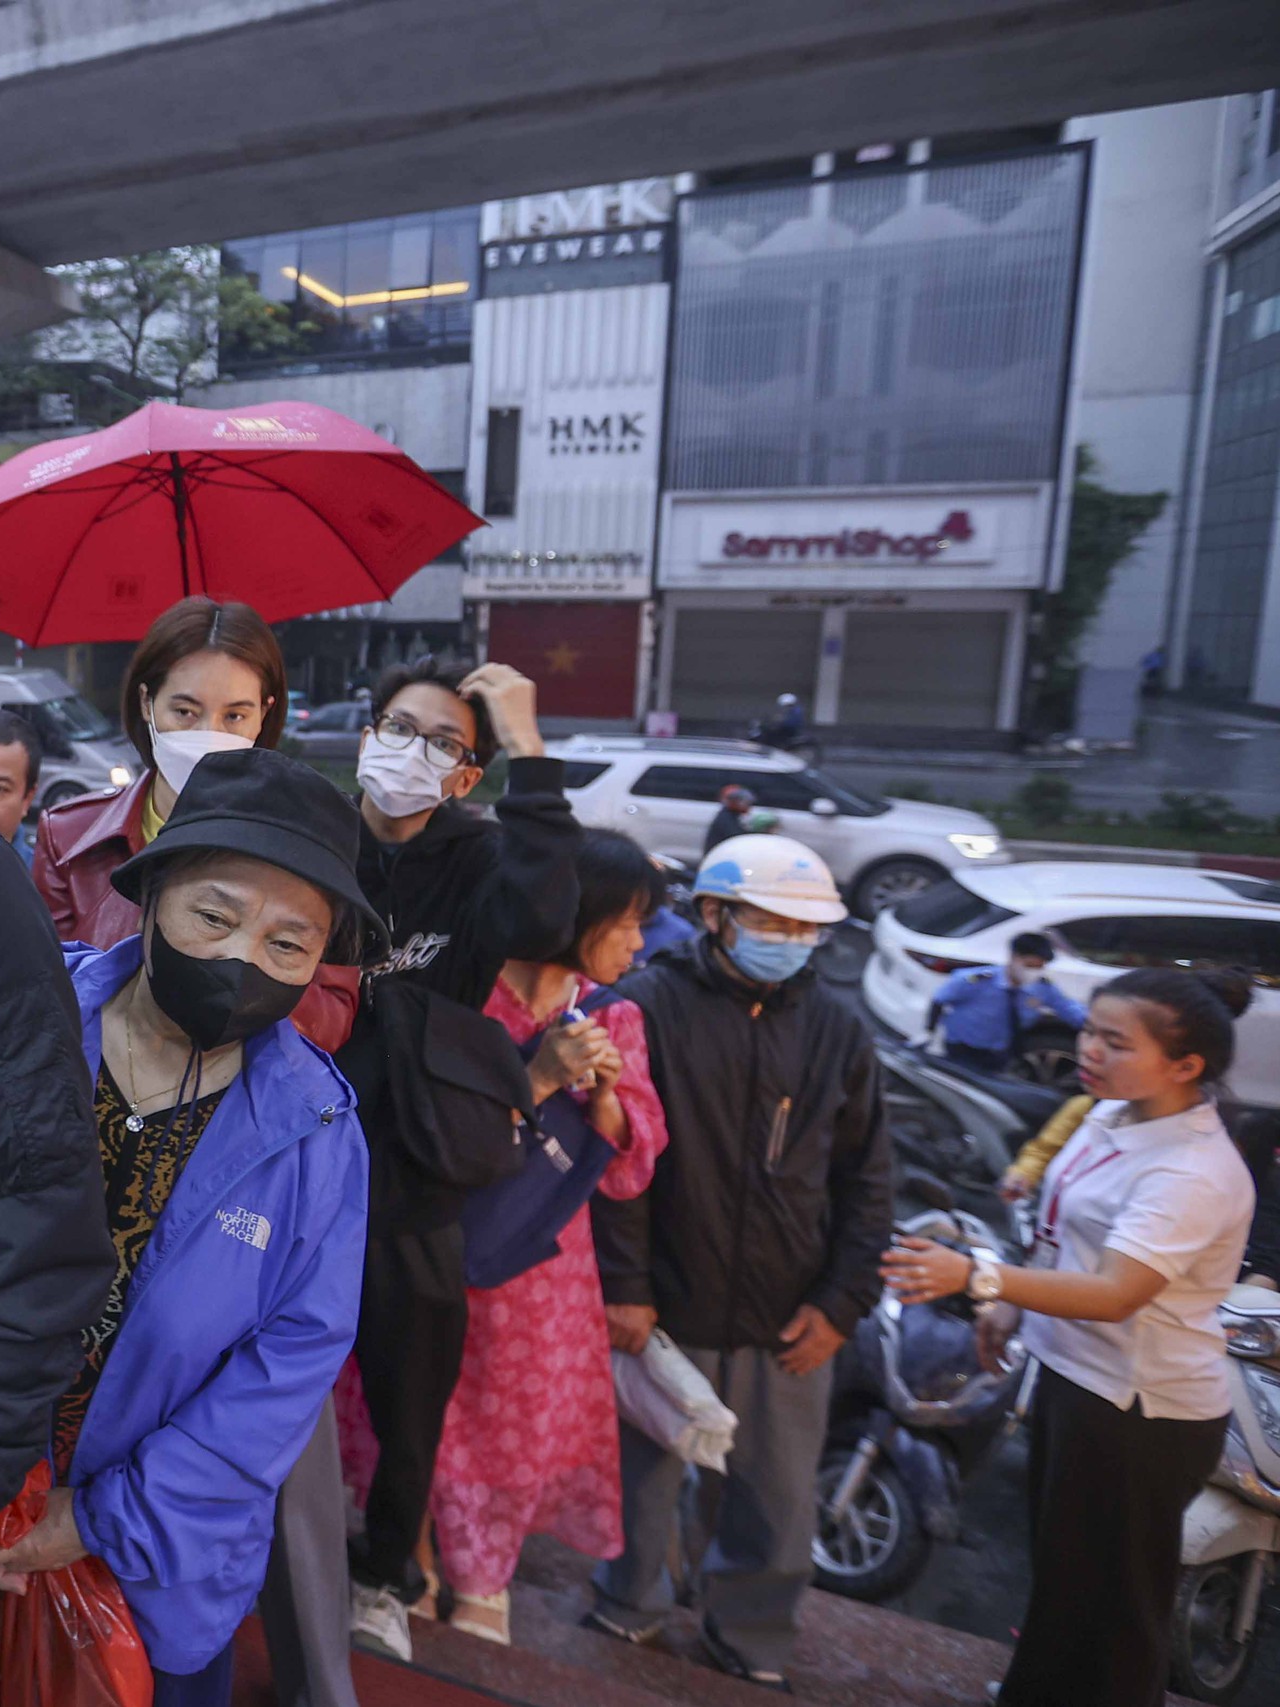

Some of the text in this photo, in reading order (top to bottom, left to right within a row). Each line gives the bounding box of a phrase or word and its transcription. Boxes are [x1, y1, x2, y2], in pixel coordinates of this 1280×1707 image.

[485, 230, 662, 269] EYEWEAR
[548, 411, 646, 440] HMK
[215, 1209, 256, 1234] NORTH
[236, 1206, 260, 1224] THE
[221, 1223, 254, 1244] FACE
